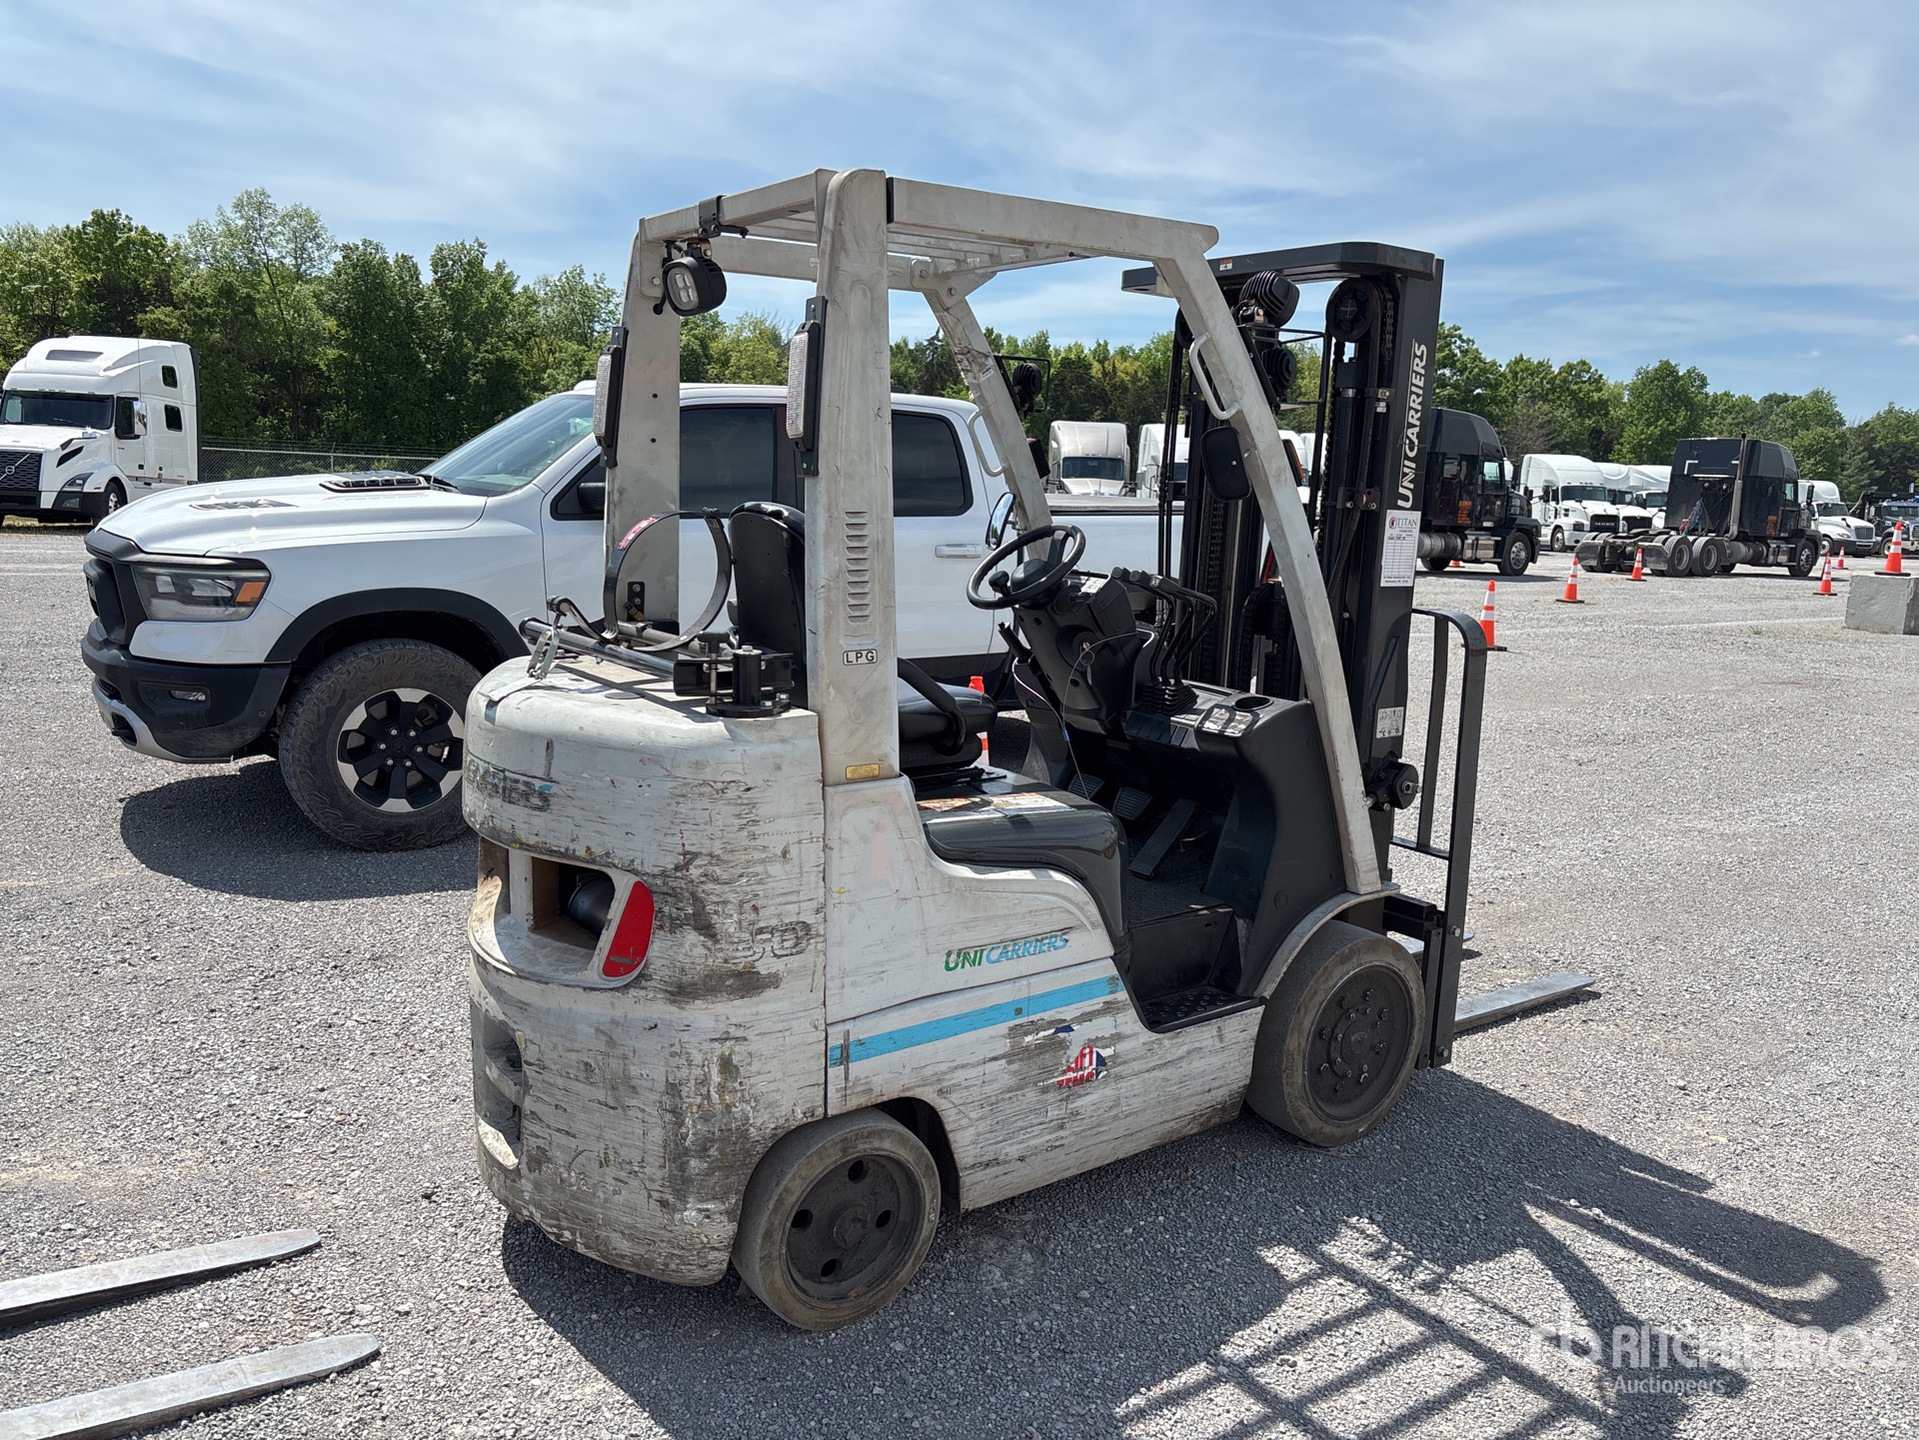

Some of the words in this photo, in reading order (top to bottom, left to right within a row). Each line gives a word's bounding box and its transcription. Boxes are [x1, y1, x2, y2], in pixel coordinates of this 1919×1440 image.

[1397, 338, 1428, 509] UNICARRIERS
[1397, 517, 1418, 527] TITAN
[845, 651, 875, 664] LPG
[944, 930, 1070, 972] UNICARRIERS
